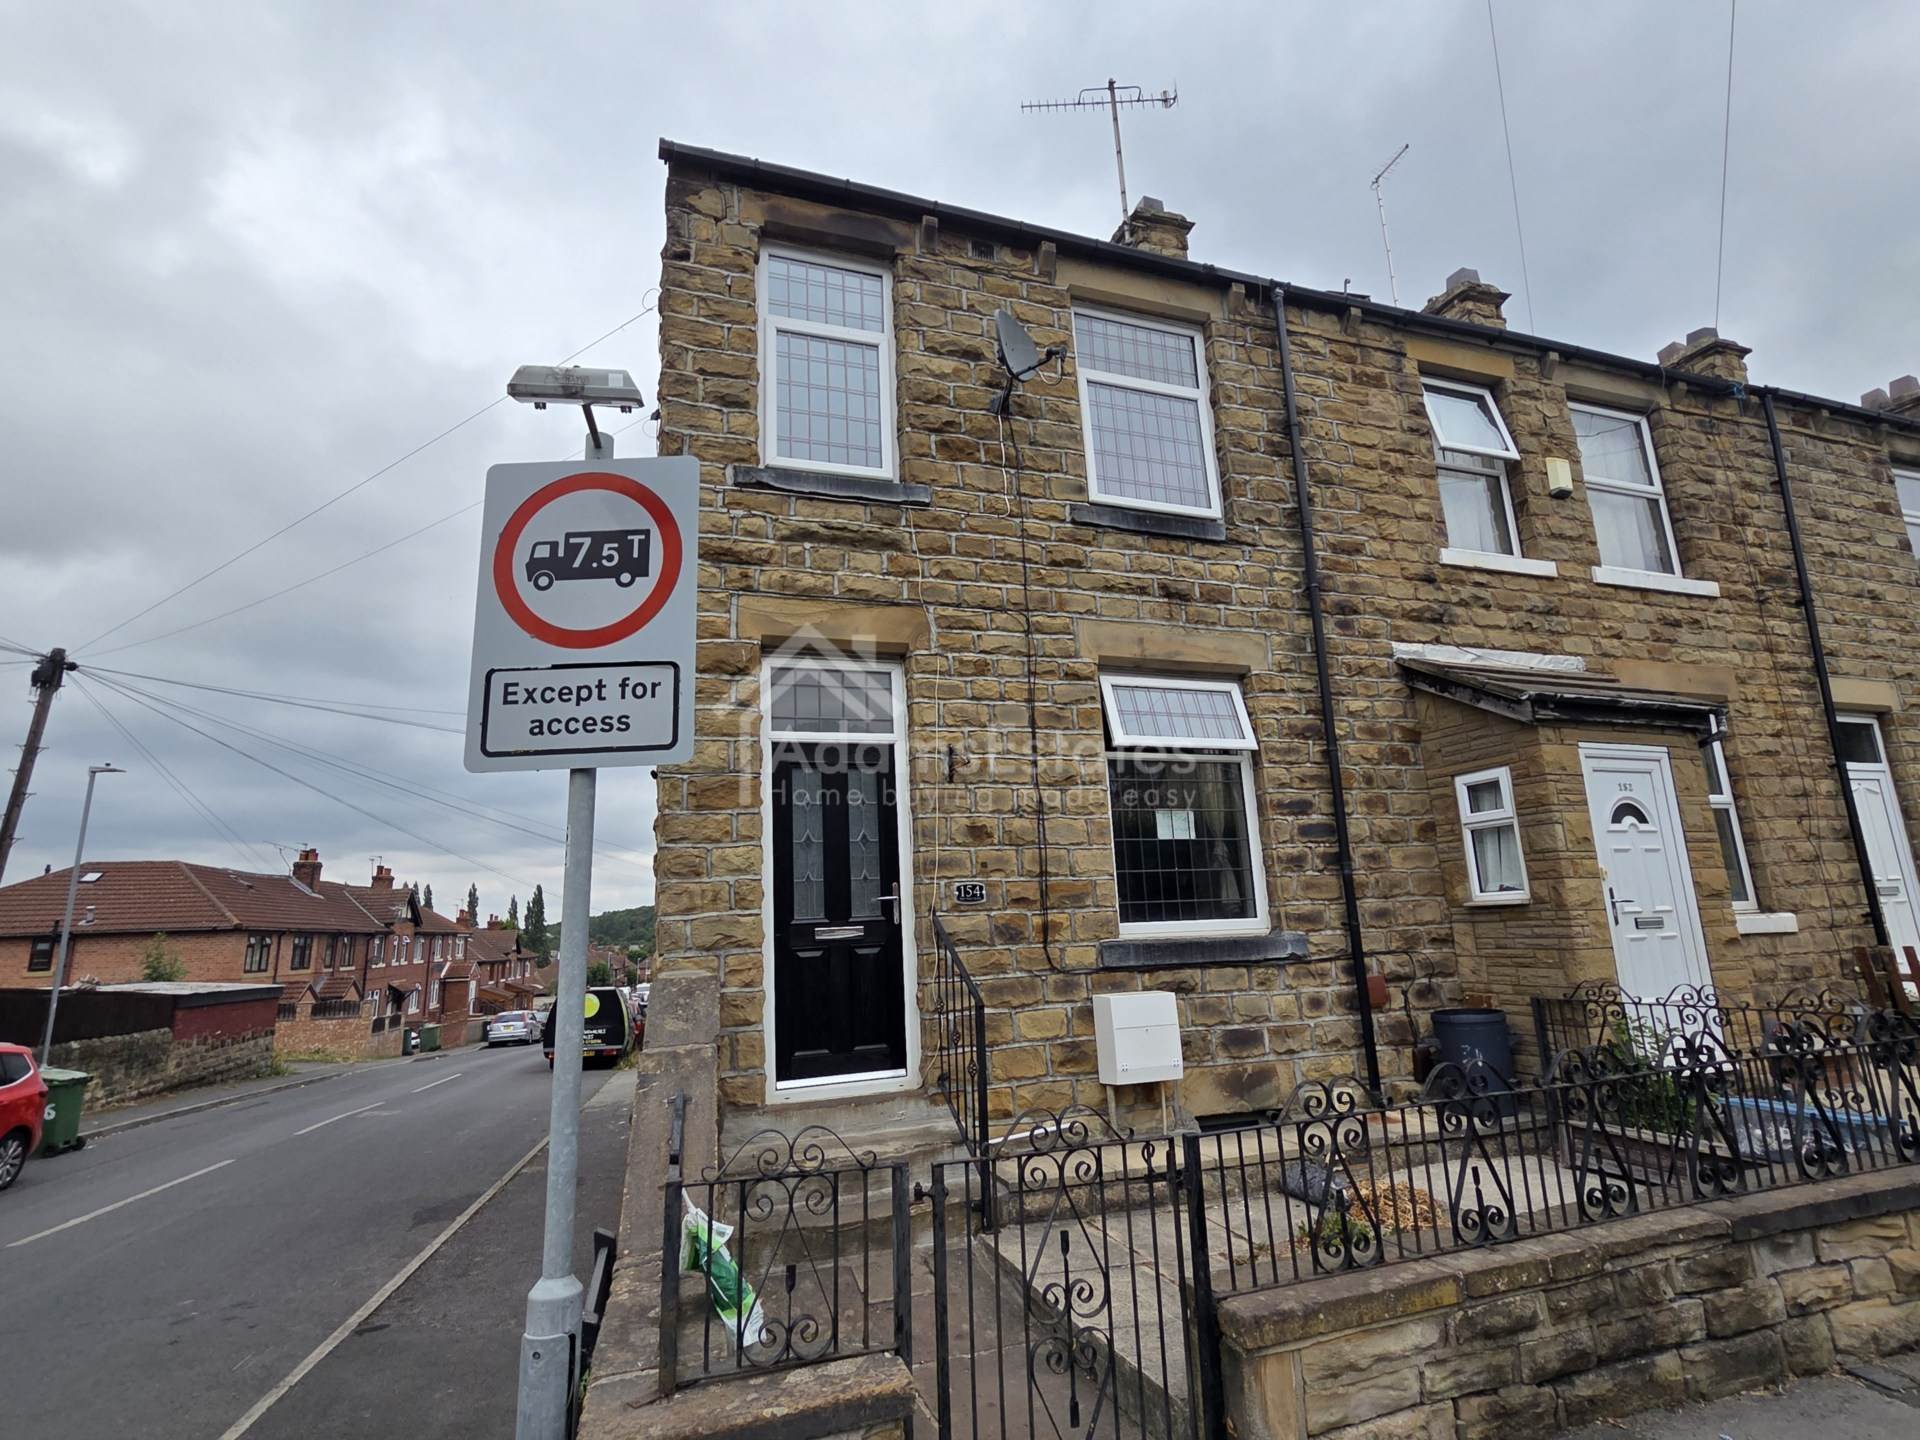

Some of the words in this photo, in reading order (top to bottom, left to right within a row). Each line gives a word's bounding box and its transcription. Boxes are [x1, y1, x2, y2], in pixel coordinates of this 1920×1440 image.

[502, 679, 606, 706] Except
[619, 677, 661, 700] for
[529, 715, 631, 736] access
[960, 885, 980, 898] 154
[44, 1103, 56, 1120] 6
